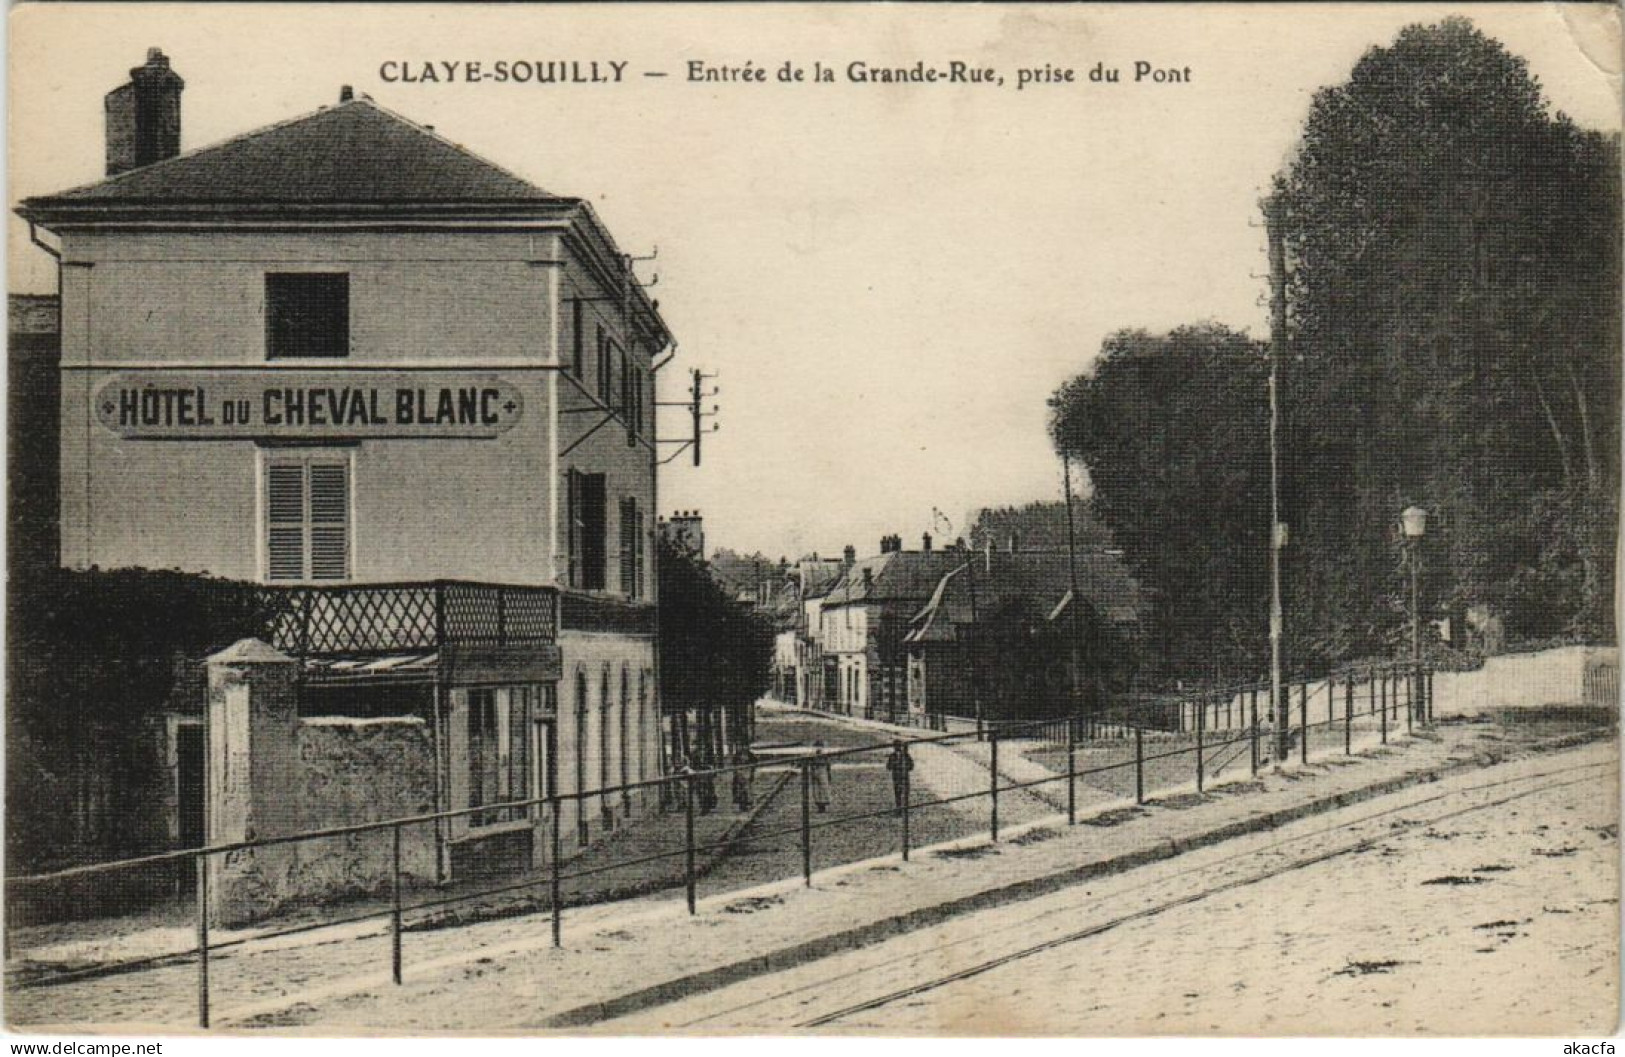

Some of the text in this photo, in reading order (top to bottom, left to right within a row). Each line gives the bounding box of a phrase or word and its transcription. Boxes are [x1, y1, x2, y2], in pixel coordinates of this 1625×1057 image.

[119, 384, 501, 427] HÔTEL DU CHEVAL BLANC
